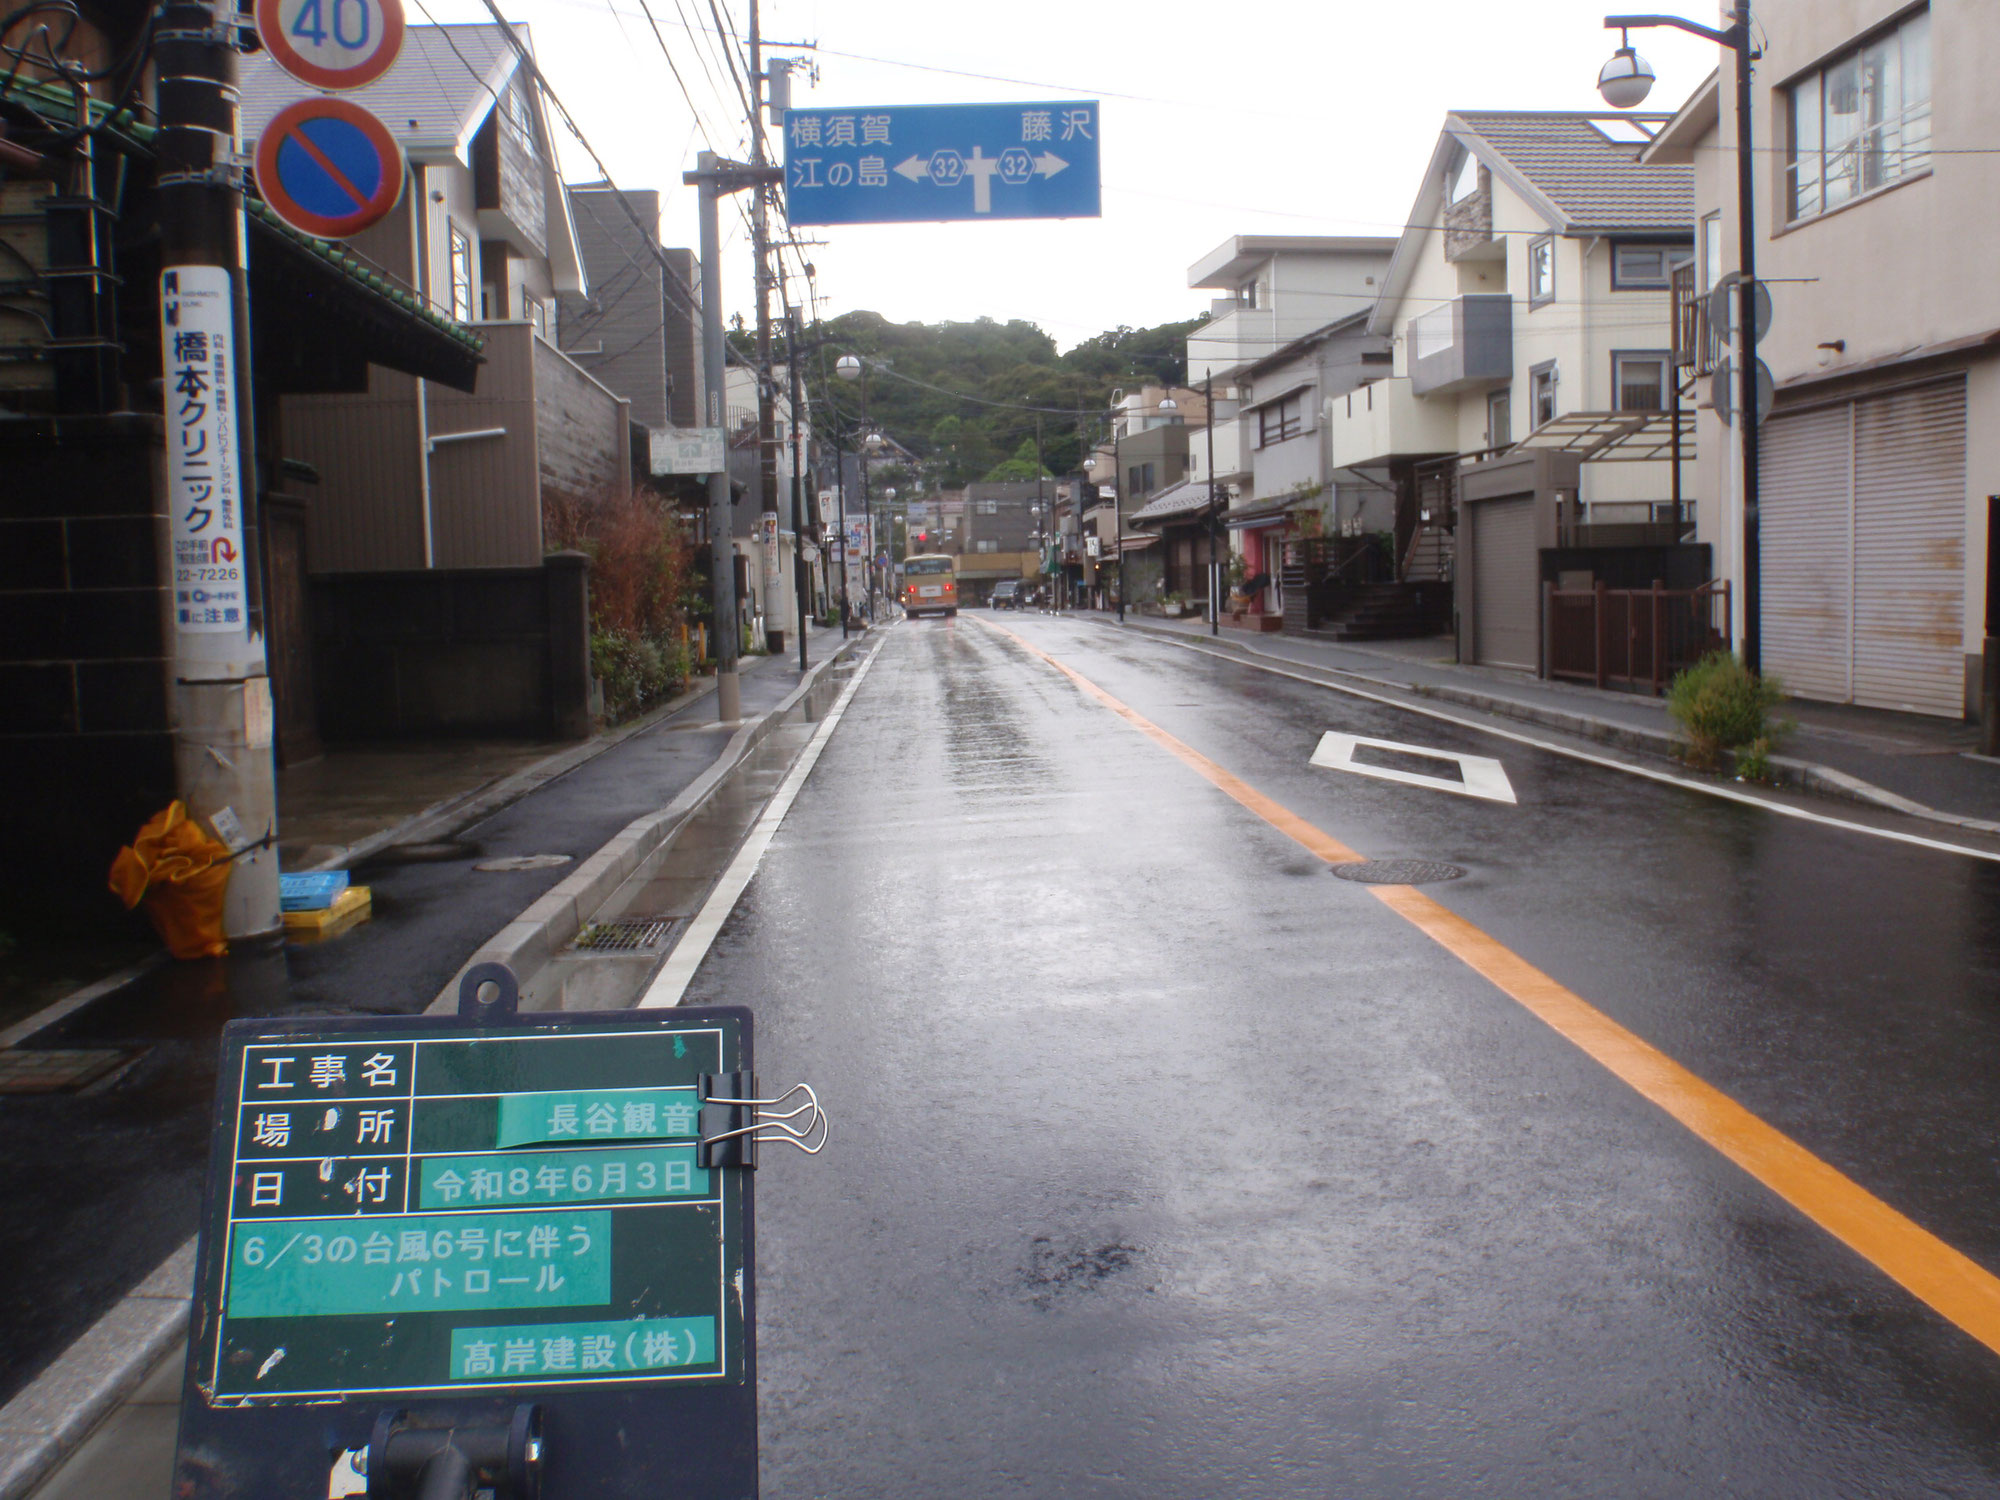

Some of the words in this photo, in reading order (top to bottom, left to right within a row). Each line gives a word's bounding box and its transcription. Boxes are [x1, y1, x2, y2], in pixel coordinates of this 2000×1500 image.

[292, 0, 368, 50] 40
[791, 114, 892, 148] 横須賀
[1021, 110, 1093, 142] 藤沢
[793, 155, 888, 188] 江の島
[935, 159, 959, 178] 32
[1004, 155, 1028, 176] 32
[174, 331, 212, 533] 橋本クリニック
[177, 568, 238, 581] 22-7226
[258, 1053, 397, 1089] 工事名
[253, 1108, 395, 1147] 場所
[547, 1102, 695, 1135] 長谷観音
[251, 1166, 392, 1207] 日付
[432, 1160, 691, 1201] 令和8年6月3日
[390, 1264, 565, 1298] パトロール
